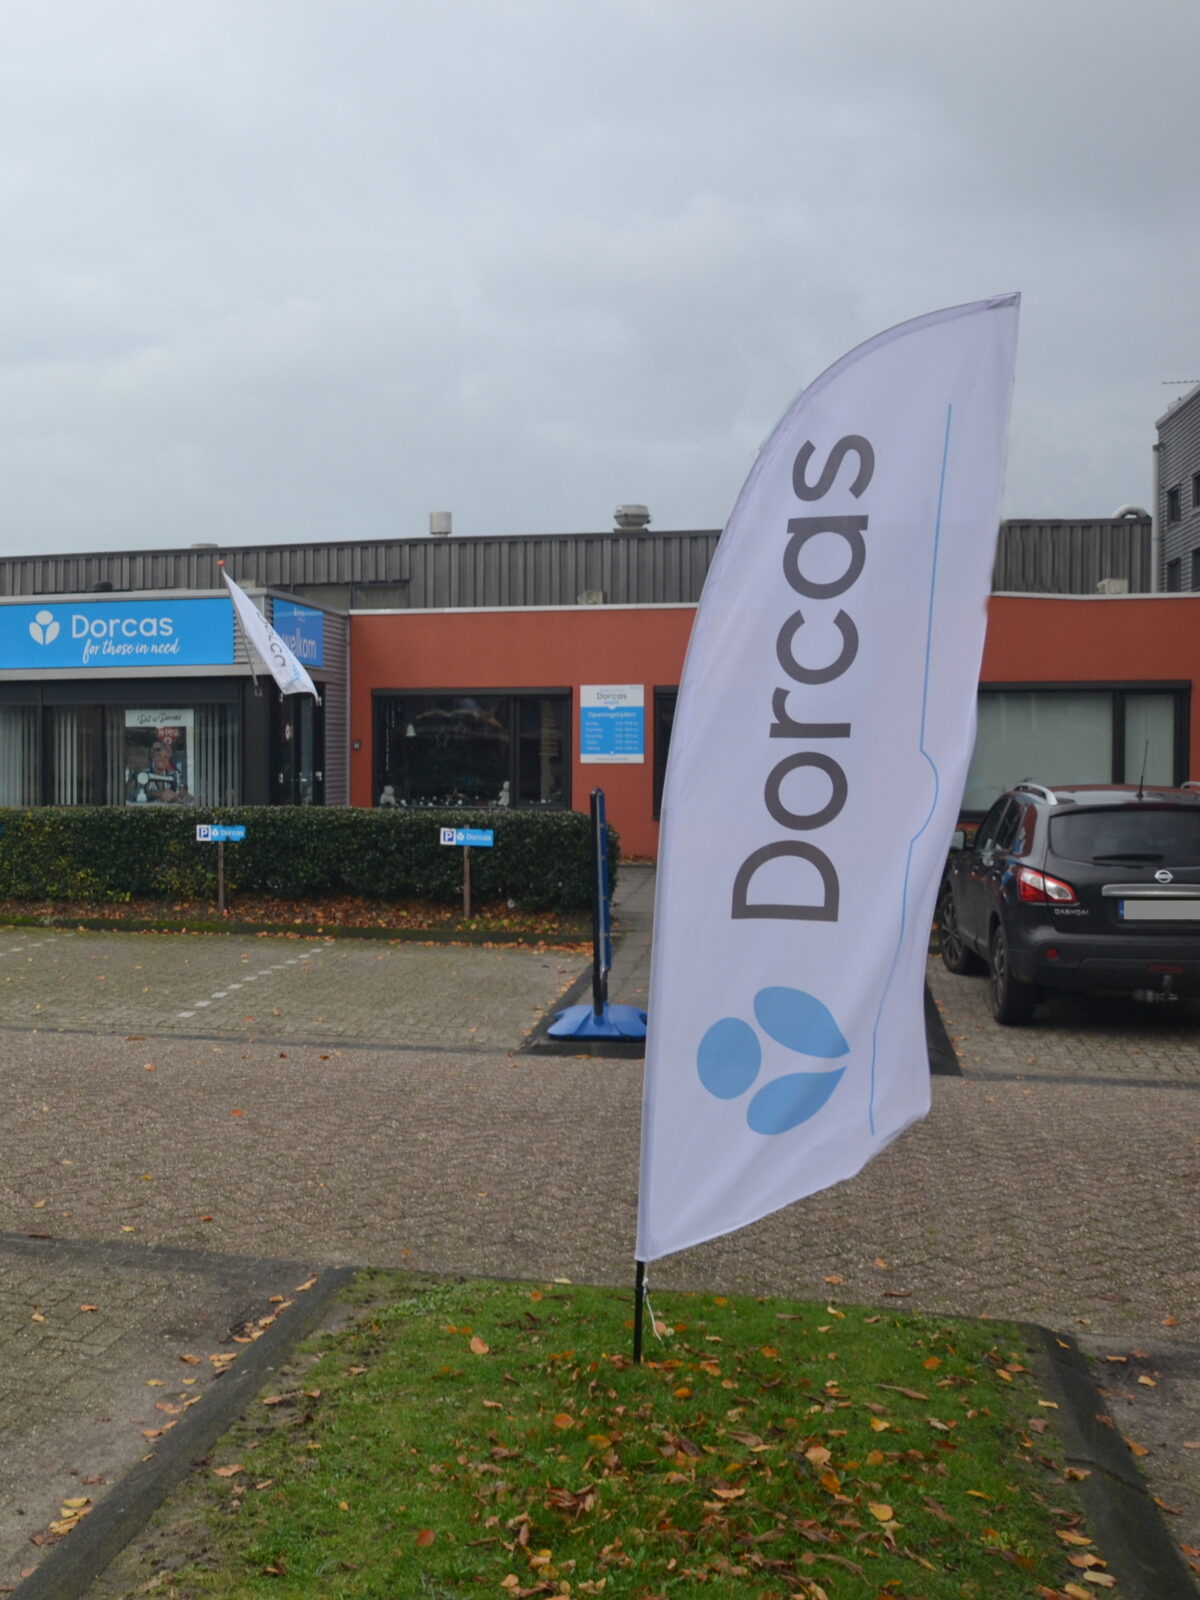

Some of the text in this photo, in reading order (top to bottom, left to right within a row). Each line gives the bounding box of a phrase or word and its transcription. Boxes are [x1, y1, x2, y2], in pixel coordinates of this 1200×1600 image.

[71, 614, 173, 639] Dorcas
[83, 638, 180, 664] for those in need
[731, 434, 876, 922] Dorcas
[597, 692, 627, 700] Dorcas
